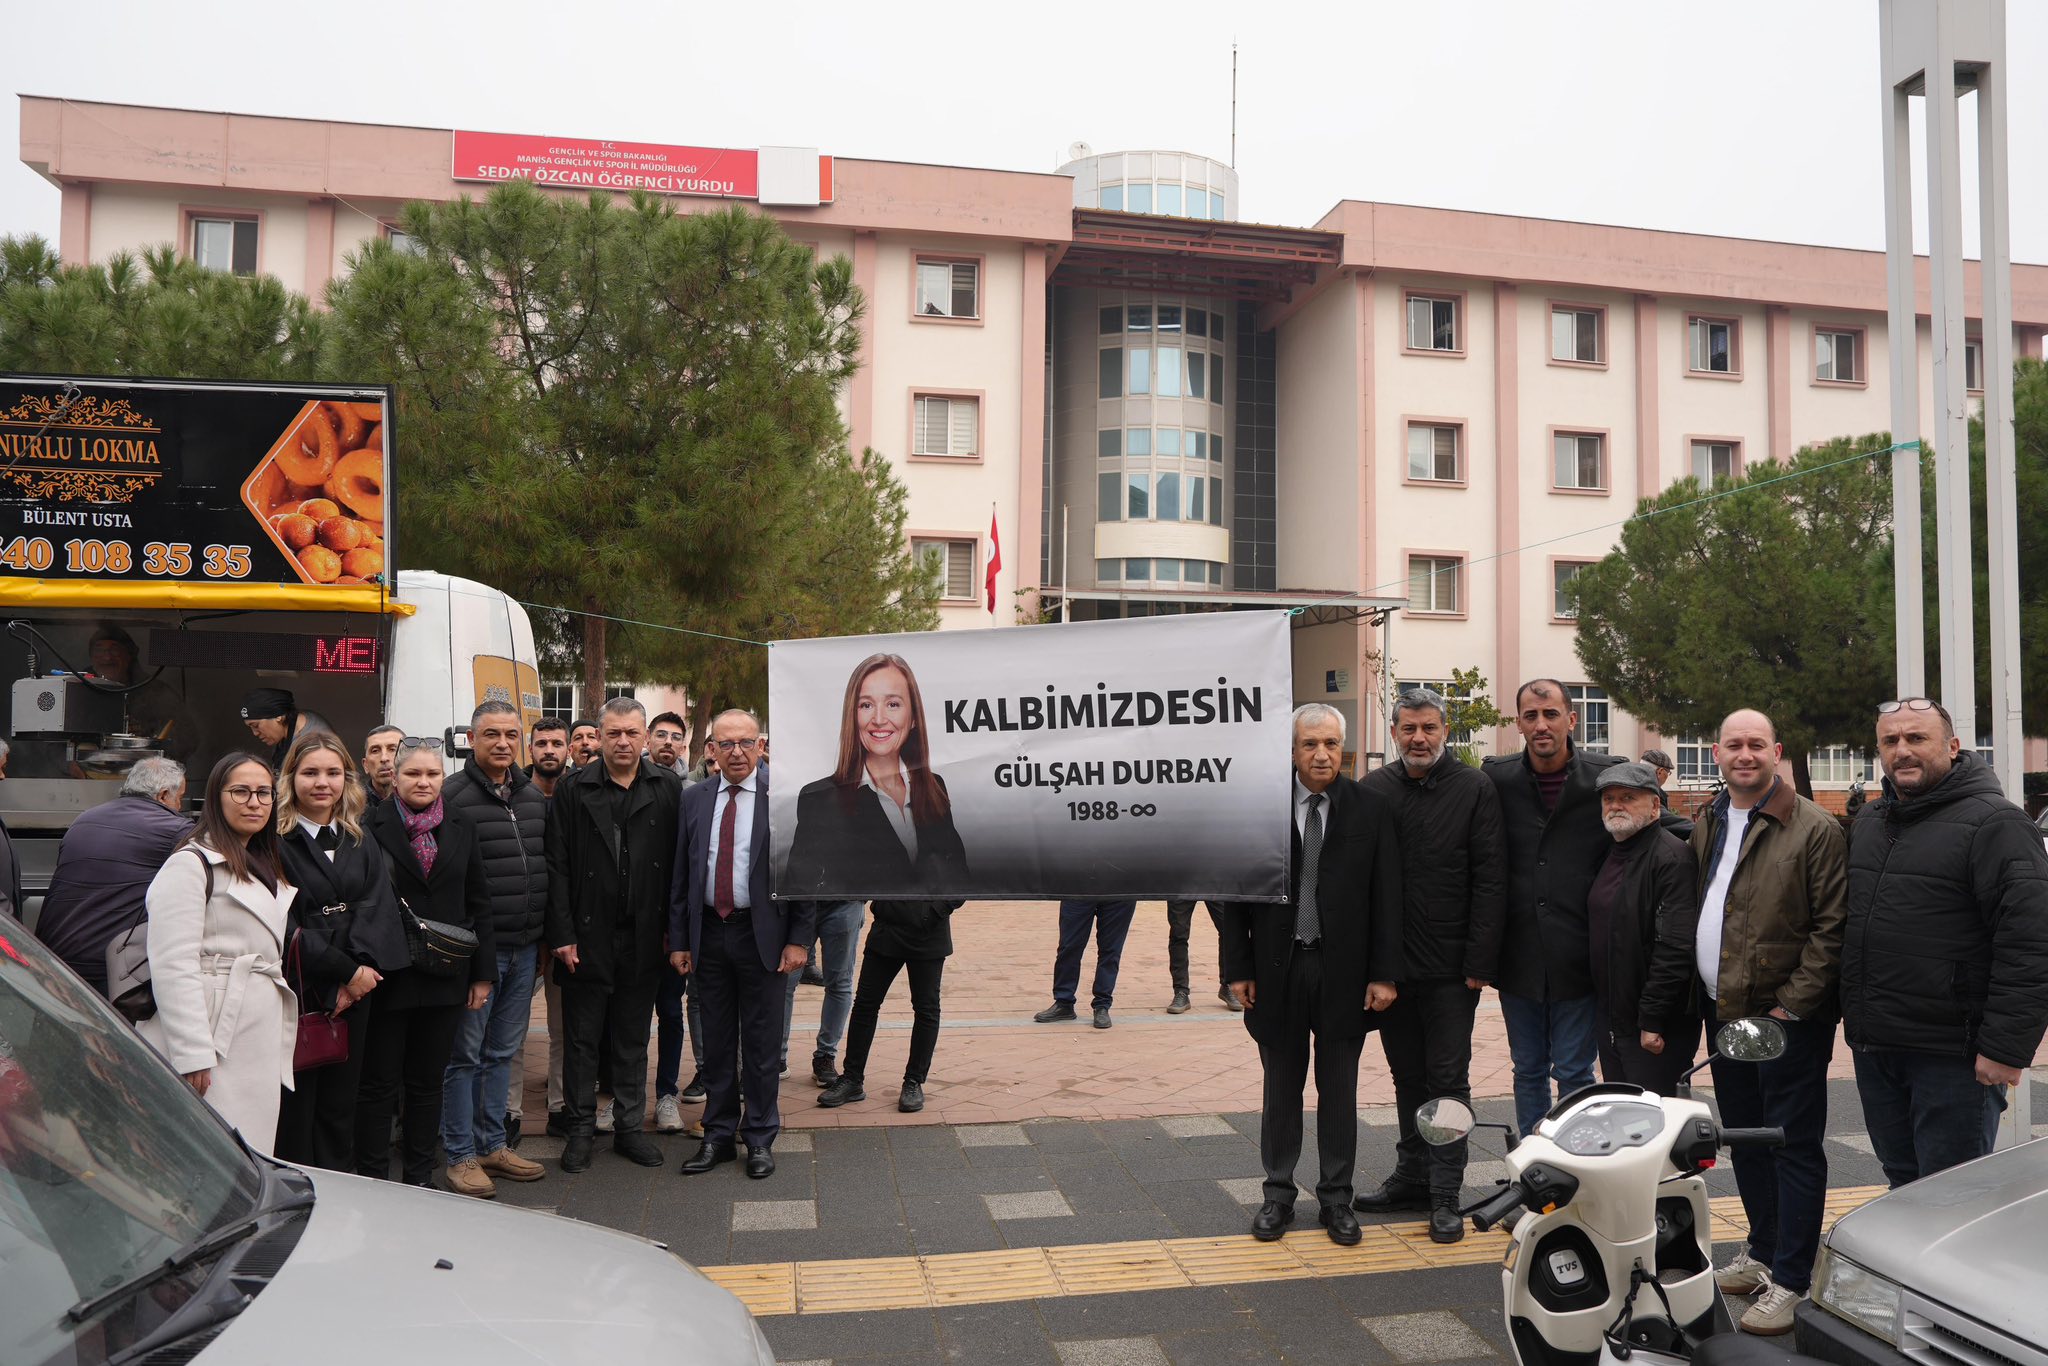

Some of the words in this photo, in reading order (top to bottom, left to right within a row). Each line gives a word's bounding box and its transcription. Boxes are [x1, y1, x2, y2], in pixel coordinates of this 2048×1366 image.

[549, 147, 586, 157] GENÇLİK
[600, 150, 622, 158] SPOR
[623, 152, 667, 162] BAKANLIĞI
[601, 142, 616, 150] T.C.
[517, 155, 552, 164] MANİSA
[554, 158, 591, 168] GENÇLİK
[593, 160, 605, 168] VE
[606, 161, 630, 169] SPOR
[631, 161, 639, 170] İL
[640, 163, 697, 174] MÜDÜRLÜĞÜ
[478, 165, 531, 179] SEDAT
[535, 167, 594, 184] ÖZCAN
[598, 171, 672, 189] ÖĞRENCİ
[676, 178, 735, 193] YURDU
[0, 433, 73, 461] NURLU
[80, 437, 161, 464] LOKMA
[23, 507, 88, 526] BÜLENT
[92, 513, 133, 528] USTA
[0, 536, 54, 571] 40
[64, 538, 132, 574] 108
[142, 541, 193, 576] 35
[202, 544, 252, 578] 35
[944, 676, 1263, 733] KALBİMİZDESİN
[994, 755, 1105, 794] GÜLŞAH
[1112, 757, 1232, 785] DURBAY
[1556, 1260, 1578, 1274] TVS
